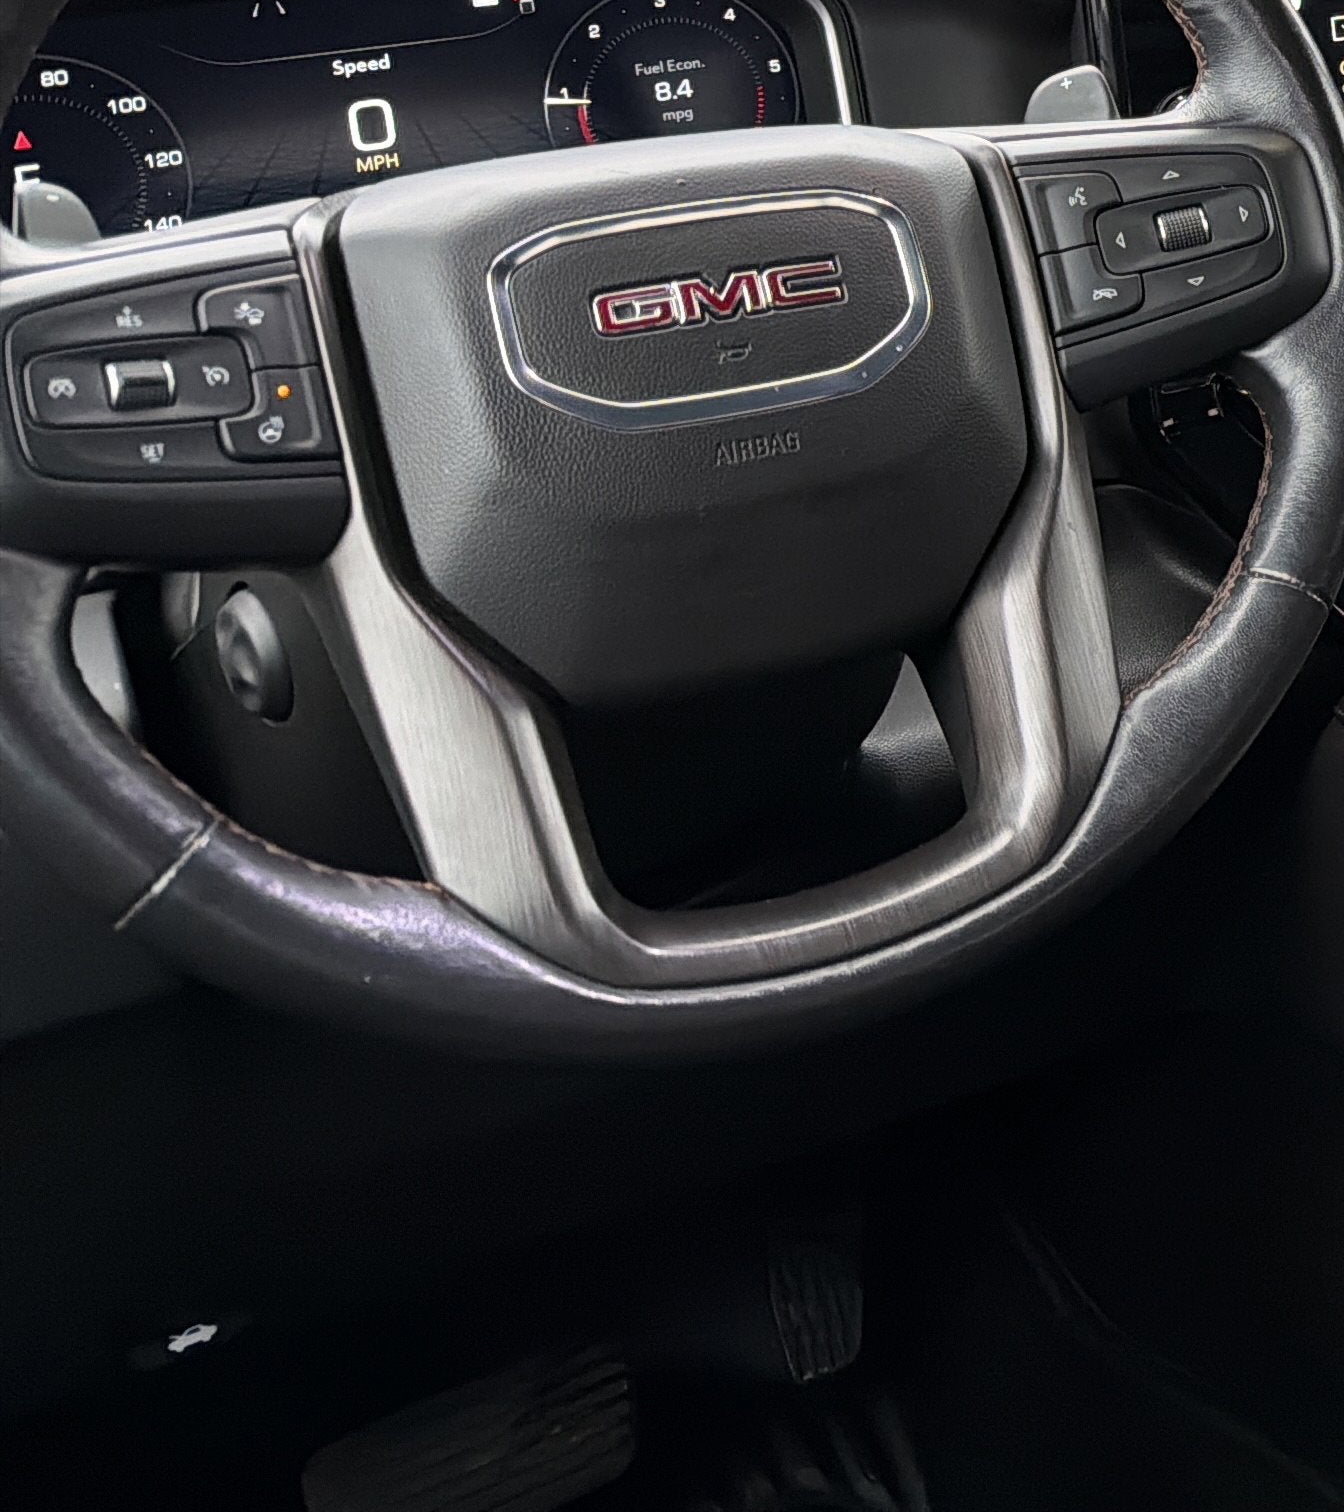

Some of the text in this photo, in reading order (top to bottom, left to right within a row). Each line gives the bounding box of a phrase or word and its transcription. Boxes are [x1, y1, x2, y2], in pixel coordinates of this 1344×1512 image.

[723, 7, 737, 22] 4
[587, 24, 601, 39] 2
[332, 53, 391, 78] Speed
[635, 58, 706, 76] Fuel Econ.
[768, 59, 782, 73] 5
[40, 69, 69, 87] 80
[654, 79, 694, 102] 8.4
[107, 96, 147, 114] 100
[662, 109, 694, 122] mpg
[348, 99, 397, 151] 0
[144, 150, 183, 168] 120
[356, 153, 400, 172] MPH
[143, 215, 182, 233] 140
[591, 257, 846, 337] GMC
[715, 432, 801, 466] AIRBAG
